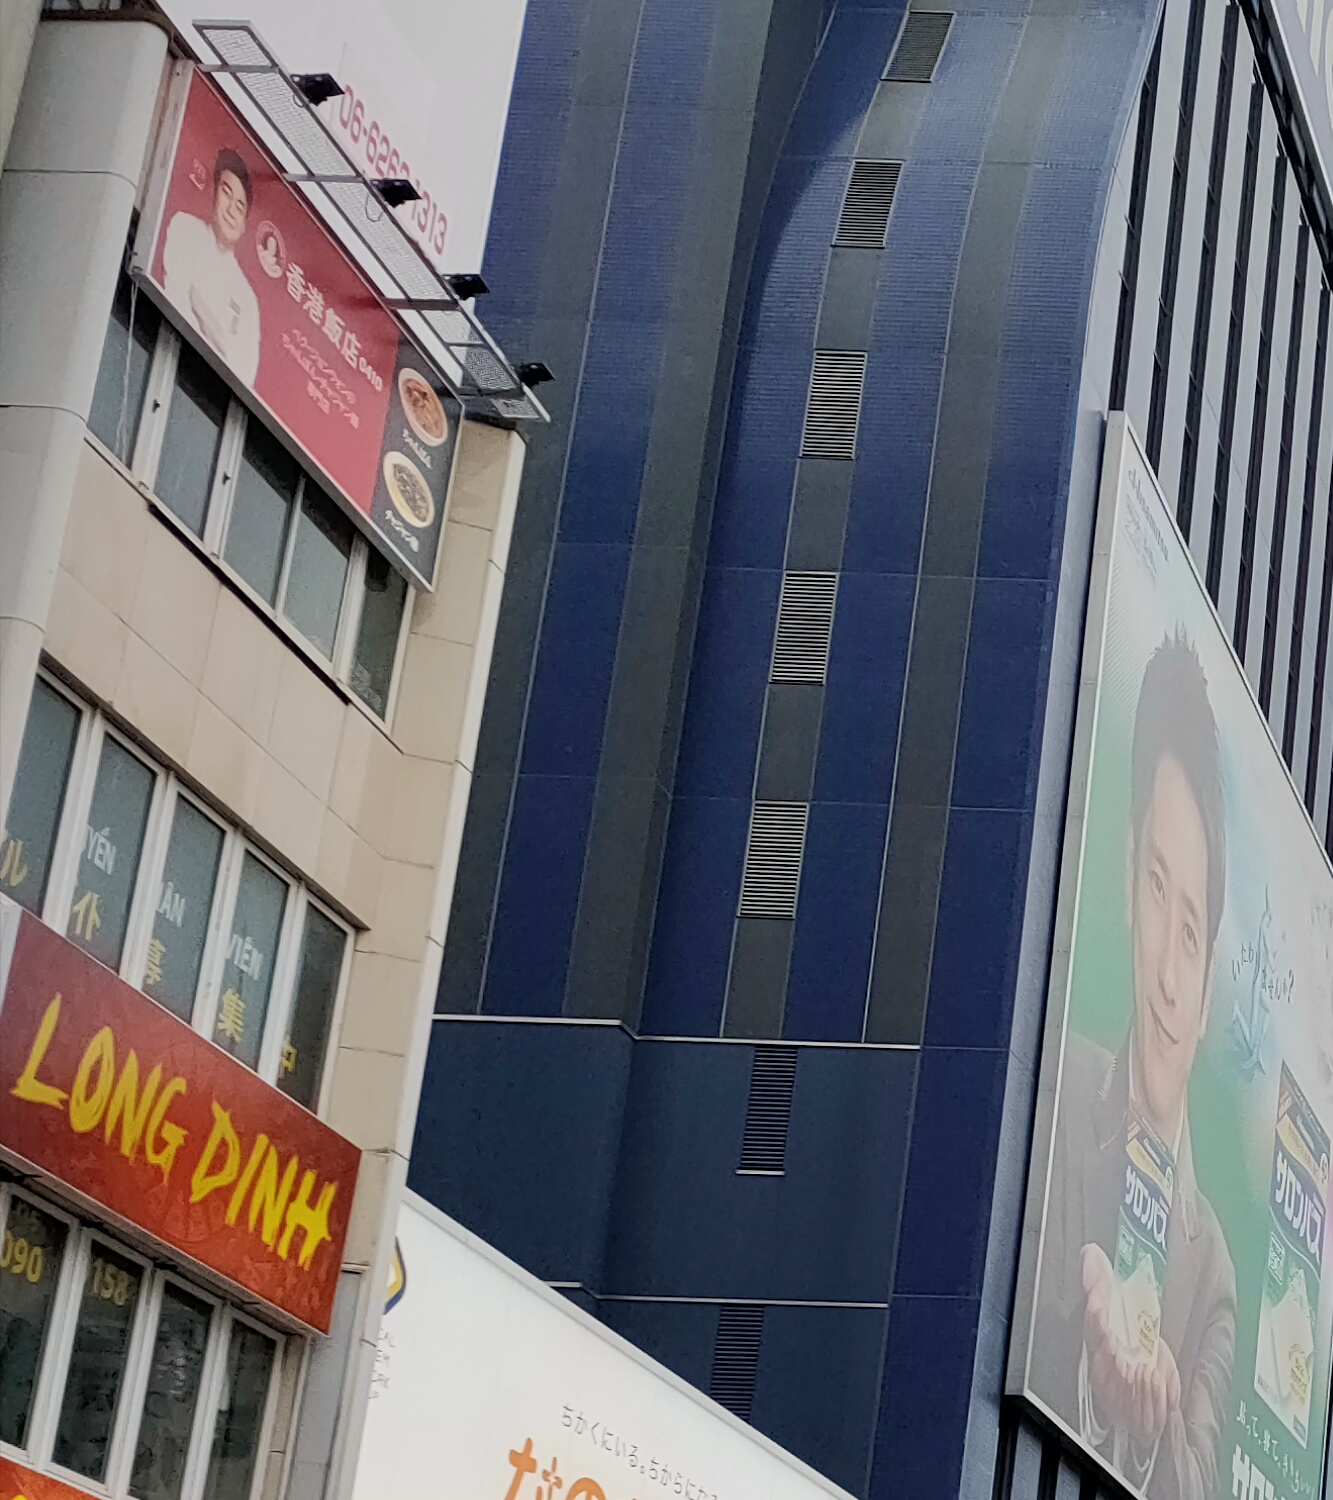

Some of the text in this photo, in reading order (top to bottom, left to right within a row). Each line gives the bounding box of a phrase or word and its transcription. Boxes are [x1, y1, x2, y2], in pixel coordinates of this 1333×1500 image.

[286, 262, 361, 369] 香港飯店
[9, 991, 337, 1272] LONG DINH
